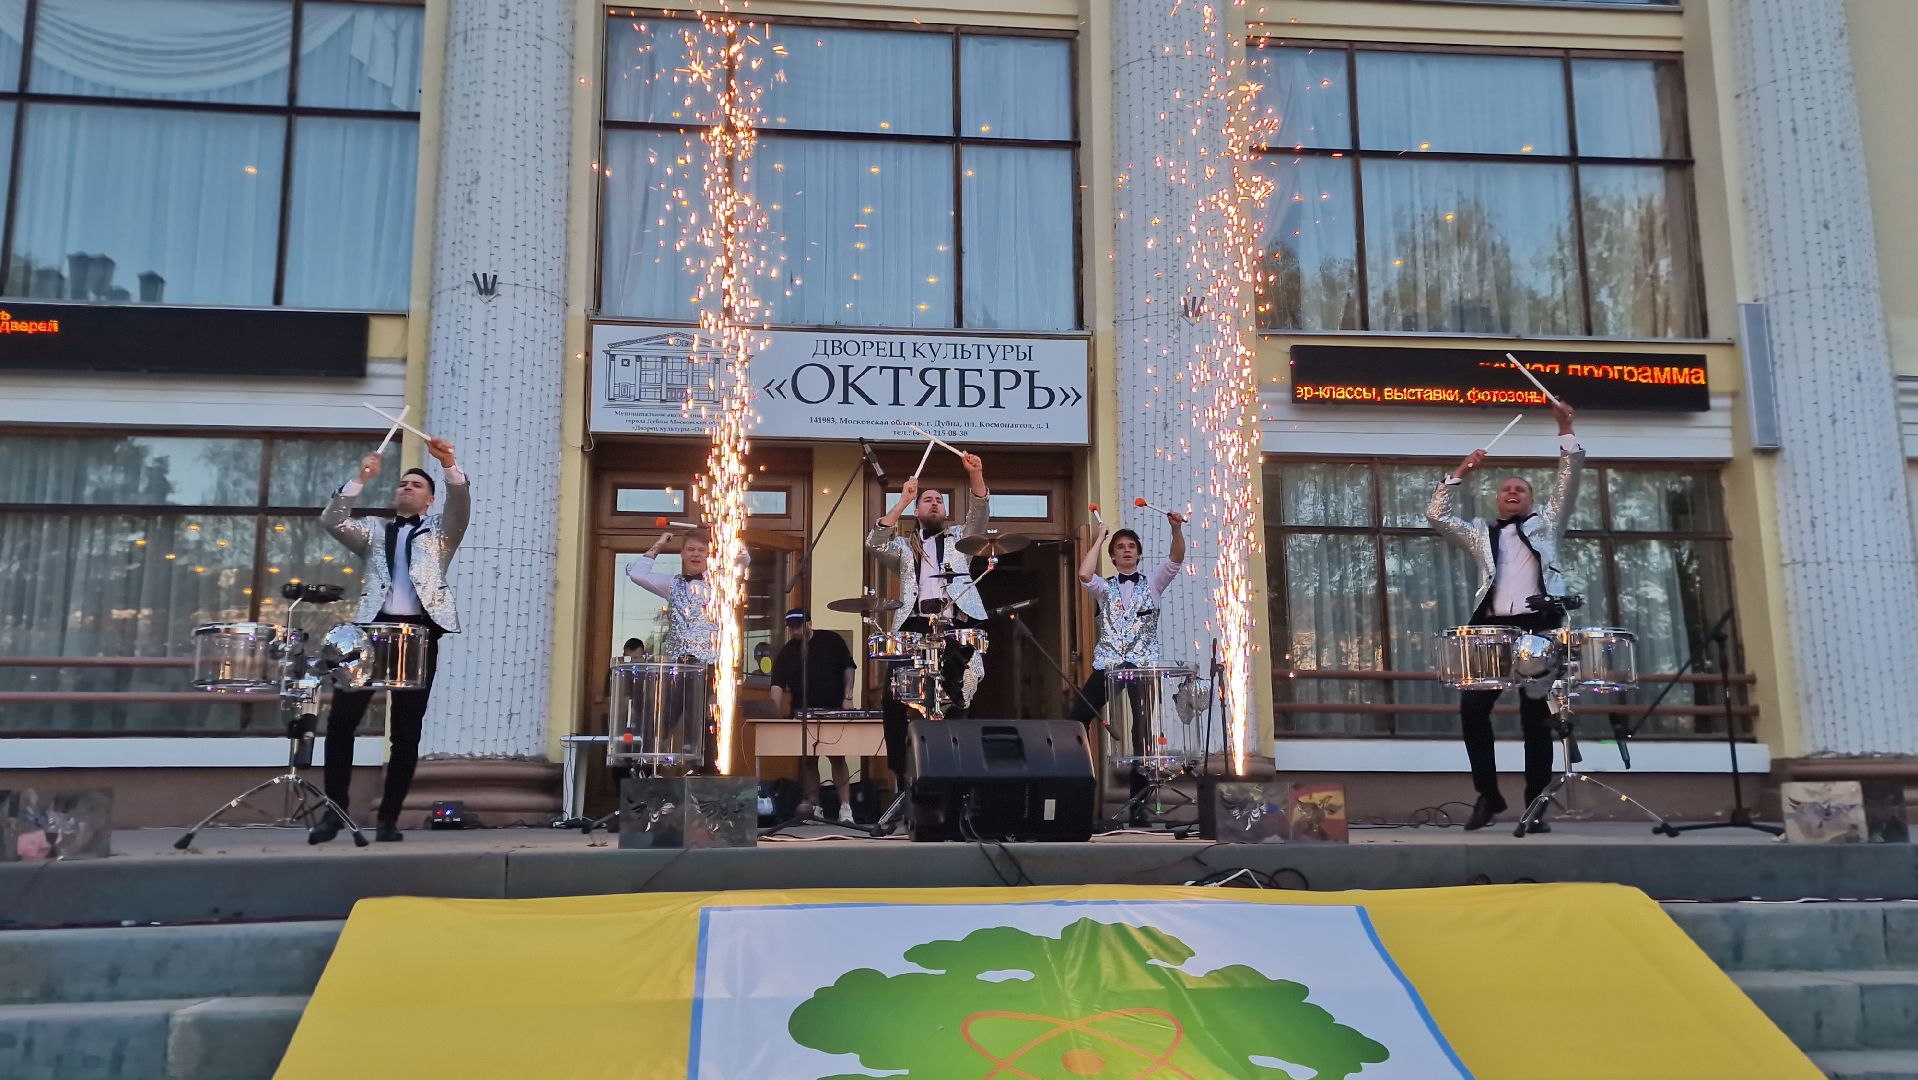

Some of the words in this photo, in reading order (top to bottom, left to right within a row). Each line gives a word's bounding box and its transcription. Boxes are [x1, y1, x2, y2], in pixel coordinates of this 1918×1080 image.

[812, 339, 906, 361] ДВОРЕЦ
[912, 342, 1033, 363] КУЛЬТУРЫ
[763, 362, 1082, 410] «ОКТЯБРЬ»
[1383, 387, 1464, 403] выставки,
[1467, 386, 1546, 404] фотозоны
